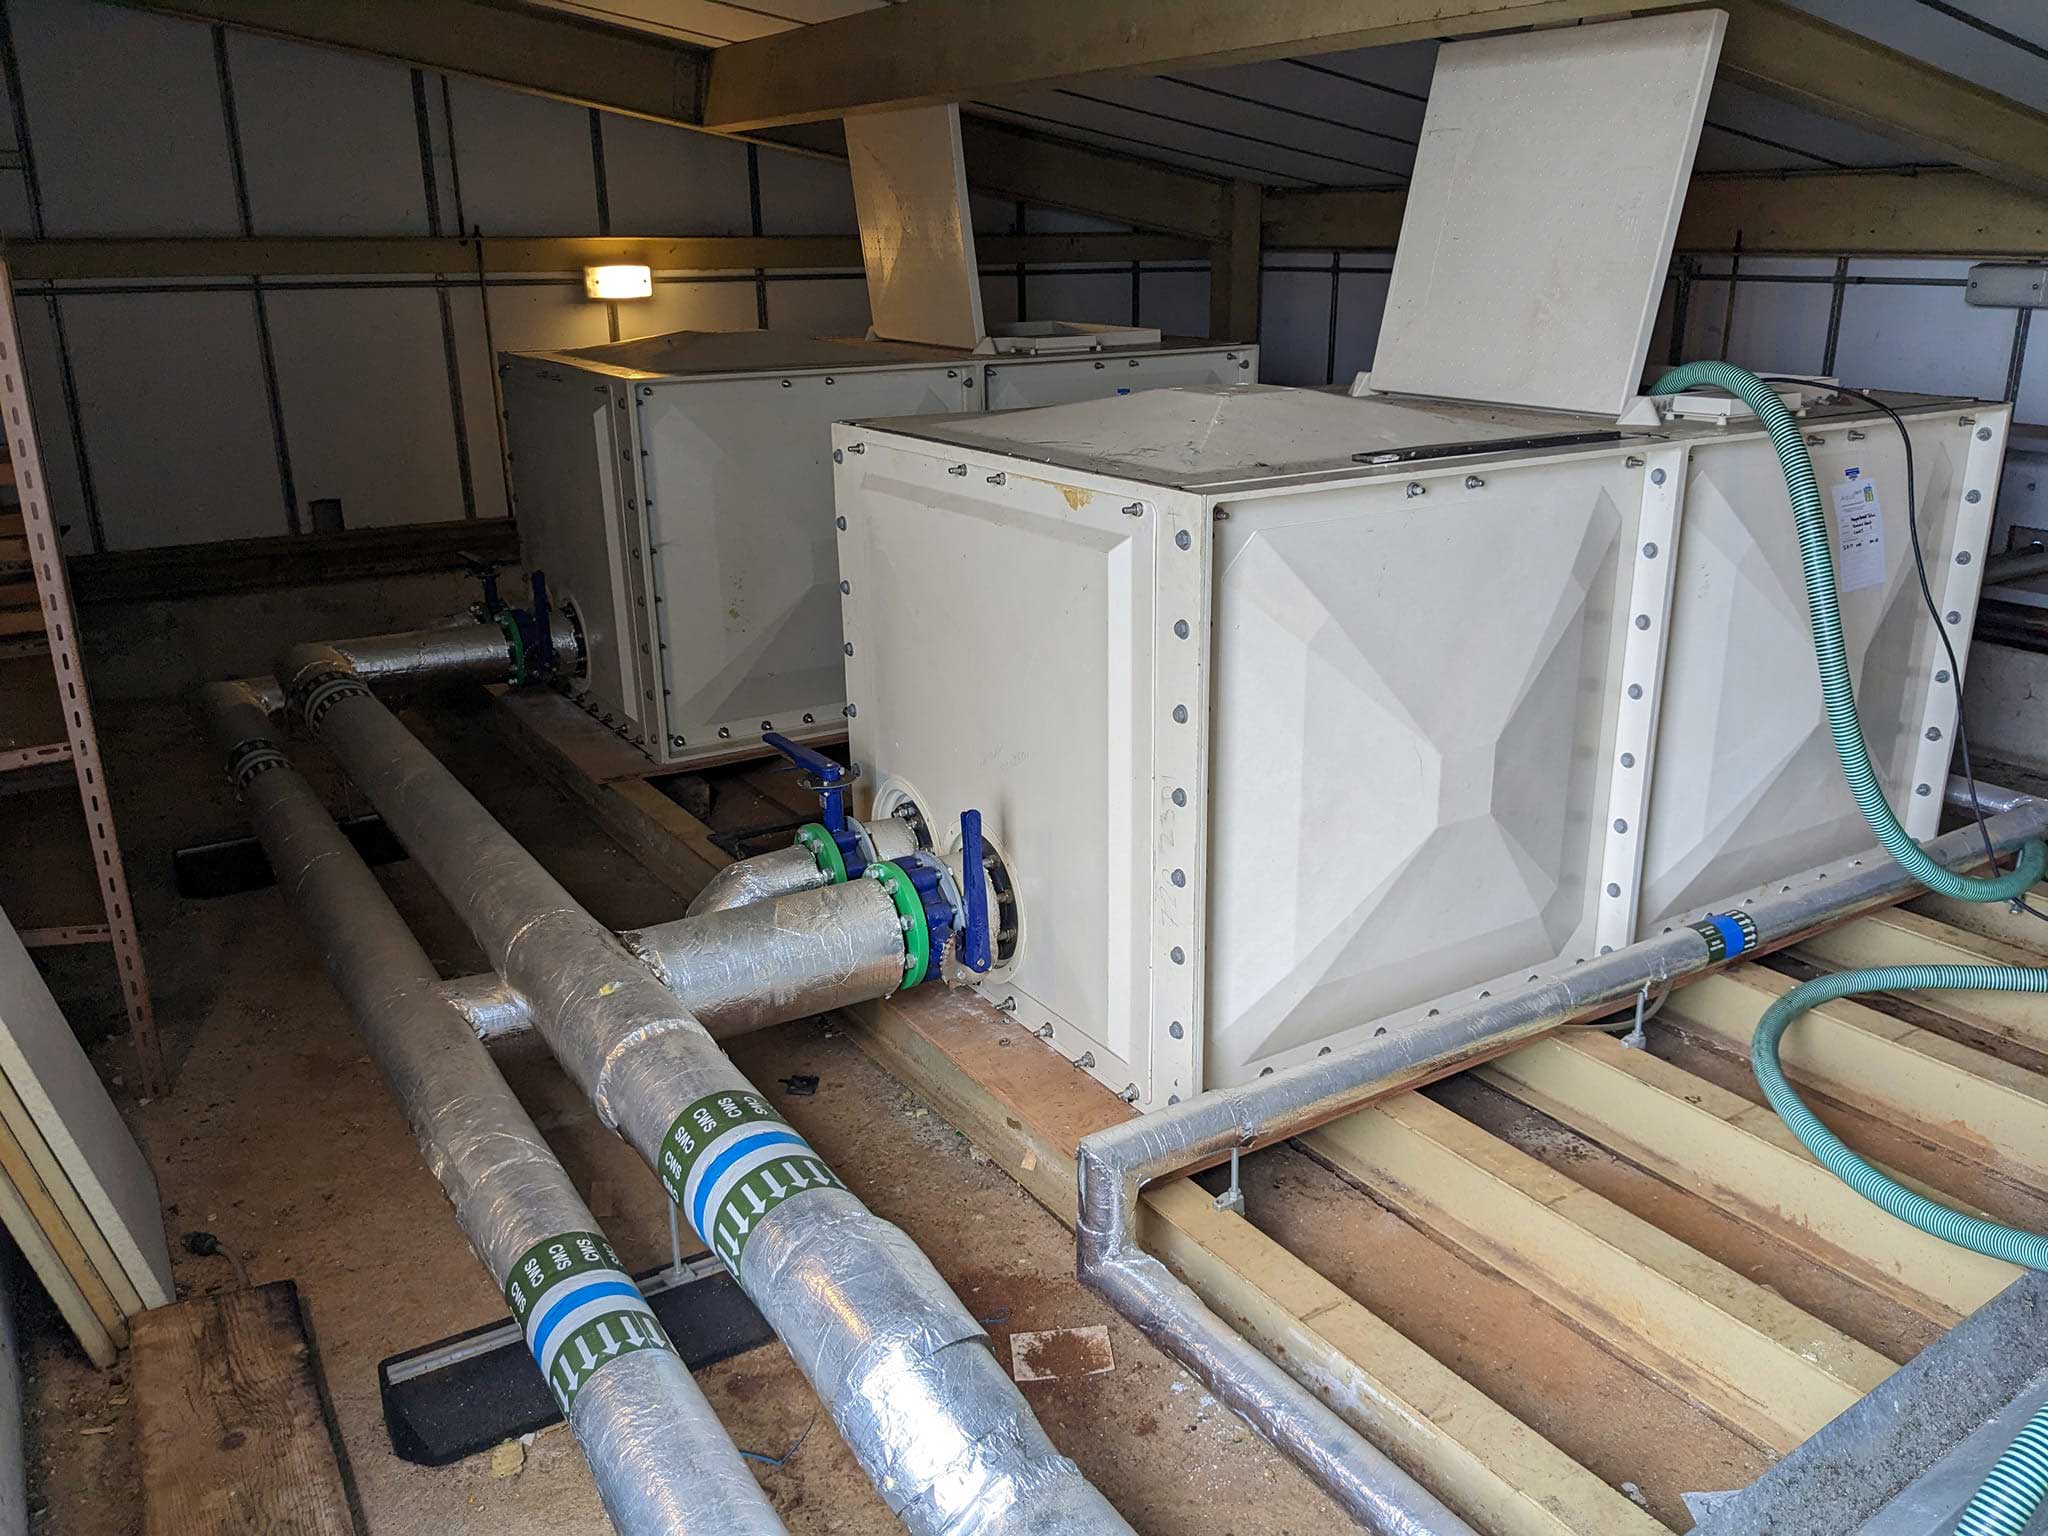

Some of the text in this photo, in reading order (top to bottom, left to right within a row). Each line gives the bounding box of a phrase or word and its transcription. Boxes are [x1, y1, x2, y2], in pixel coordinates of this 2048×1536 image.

[717, 1097, 742, 1118] CWS
[743, 1096, 768, 1115] CWS
[693, 1108, 717, 1133] CWS
[674, 1126, 695, 1154] CWS
[665, 1151, 682, 1180] CWS
[549, 1244, 572, 1271] CWS
[576, 1239, 600, 1261] CWS
[524, 1258, 544, 1288] CWS
[511, 1281, 527, 1313] CWS
